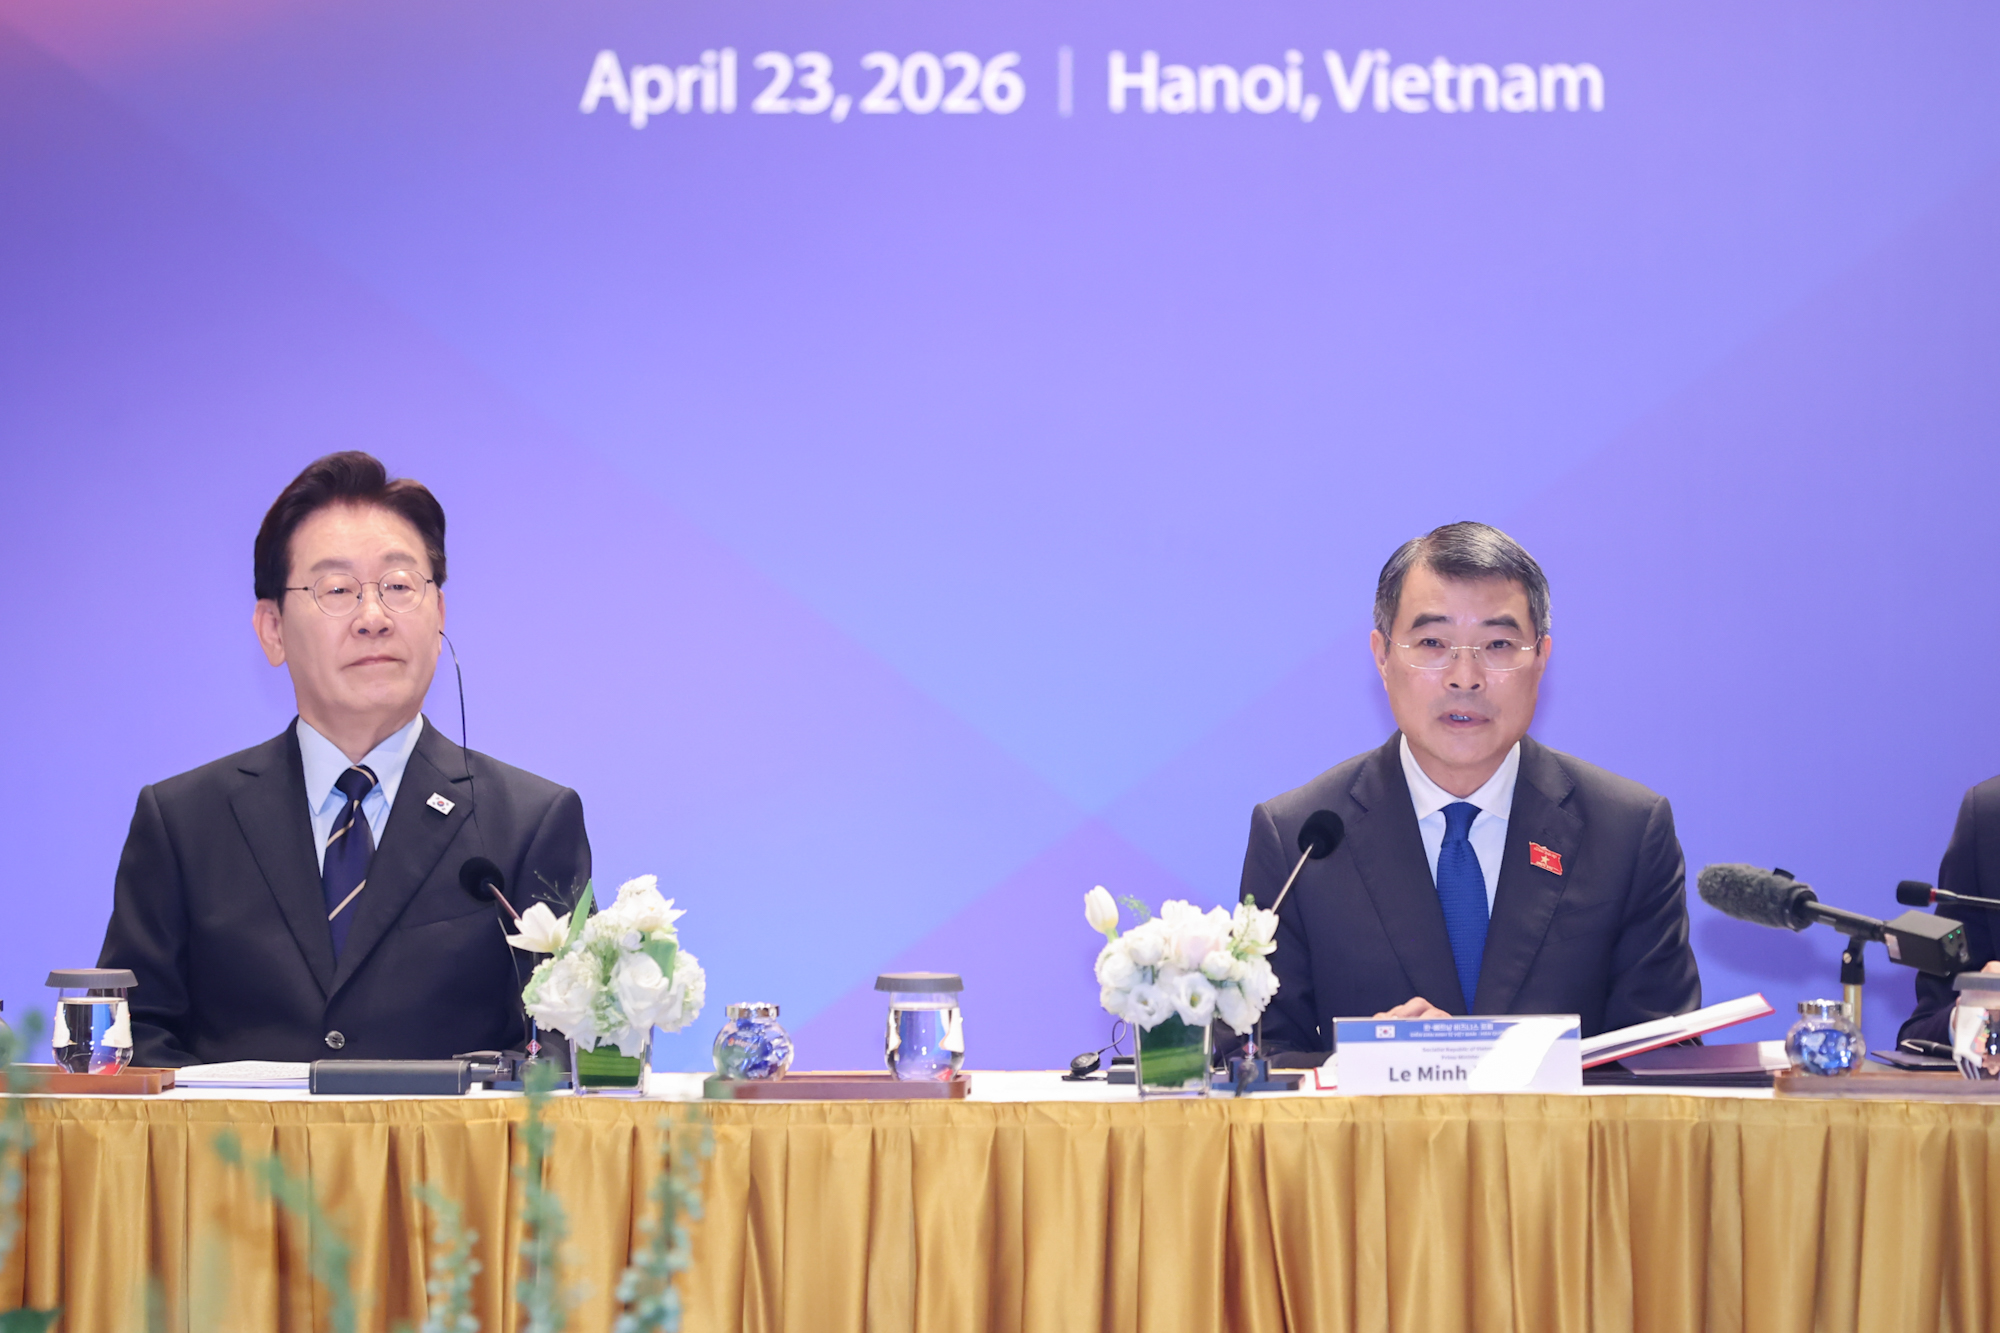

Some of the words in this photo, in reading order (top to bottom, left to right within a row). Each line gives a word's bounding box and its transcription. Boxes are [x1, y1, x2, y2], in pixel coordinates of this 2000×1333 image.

[581, 49, 737, 128] April
[753, 52, 850, 121] 23,
[860, 52, 1025, 114] 2026
[1108, 50, 1320, 121] Hanoi,
[1324, 50, 1604, 113] Vietnam
[1389, 1067, 1411, 1083] Le
[1418, 1064, 1467, 1082] Minh
